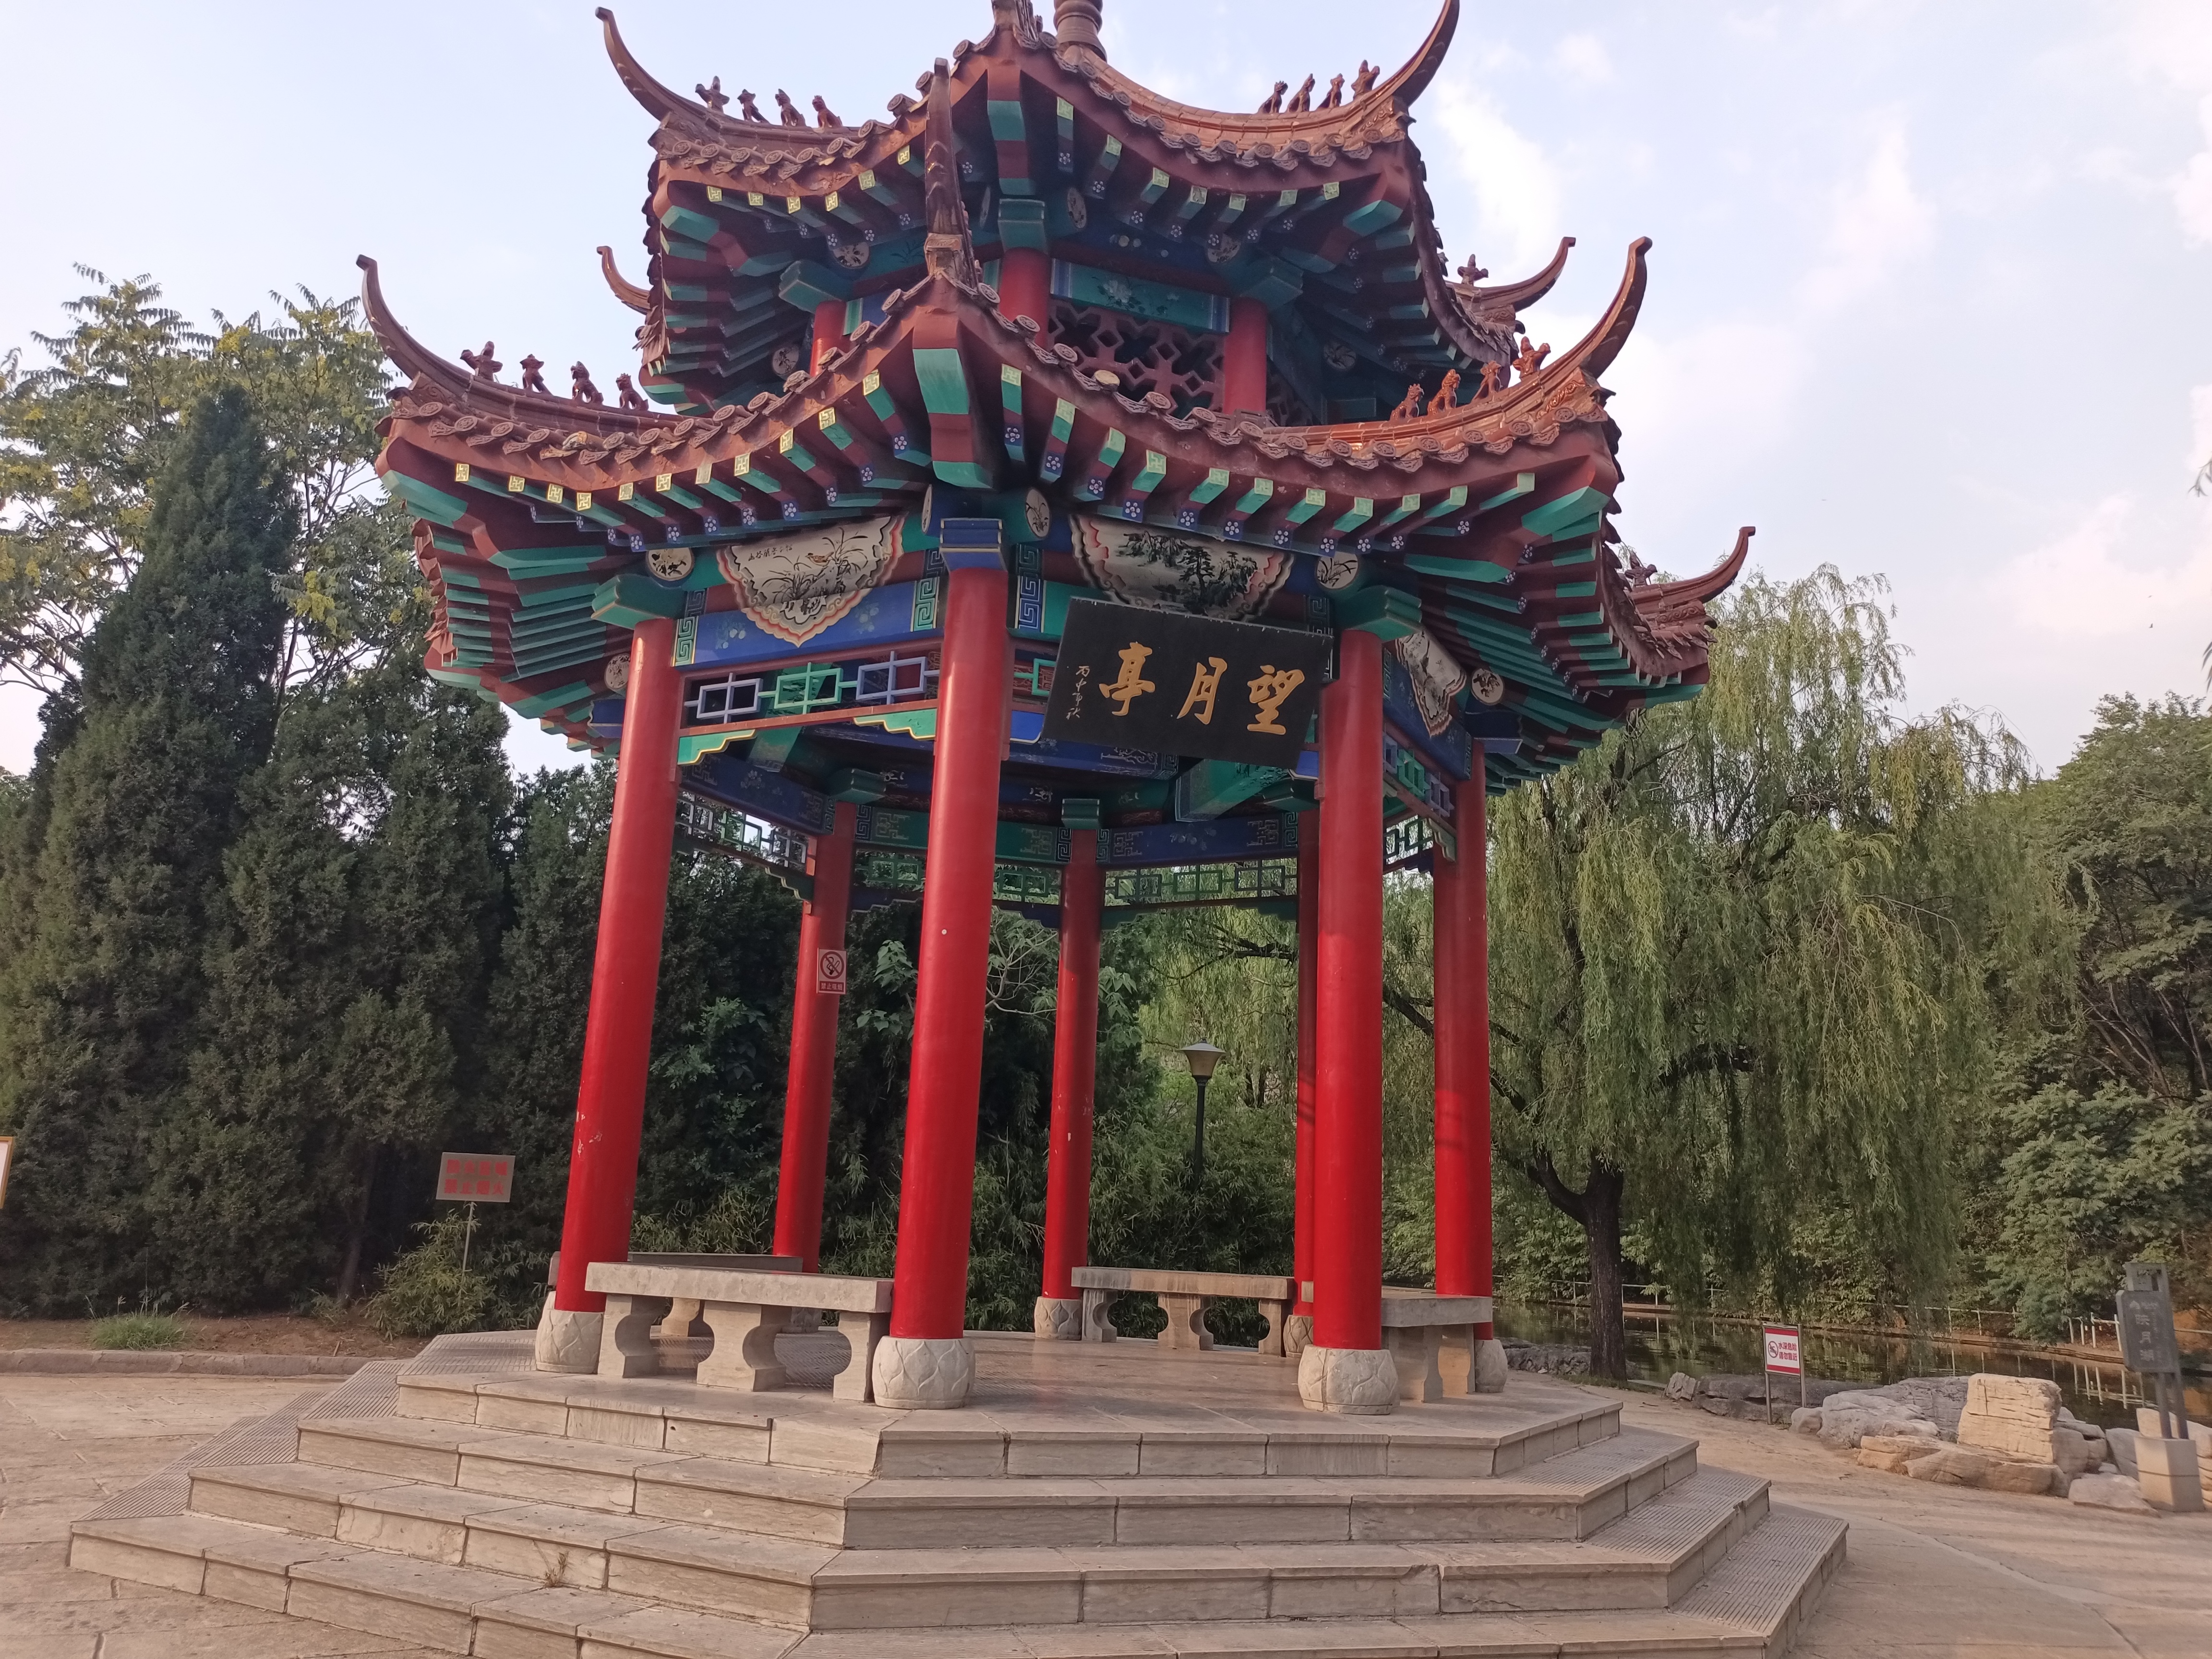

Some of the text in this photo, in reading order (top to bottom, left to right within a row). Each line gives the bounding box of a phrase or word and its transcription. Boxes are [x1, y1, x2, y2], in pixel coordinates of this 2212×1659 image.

[1099, 642, 1305, 735] 望月亭
[821, 982, 843, 991] 禁止吸烟
[1778, 1342, 1797, 1351] 水深危险
[1779, 1351, 1798, 1361] 请勿靠近
